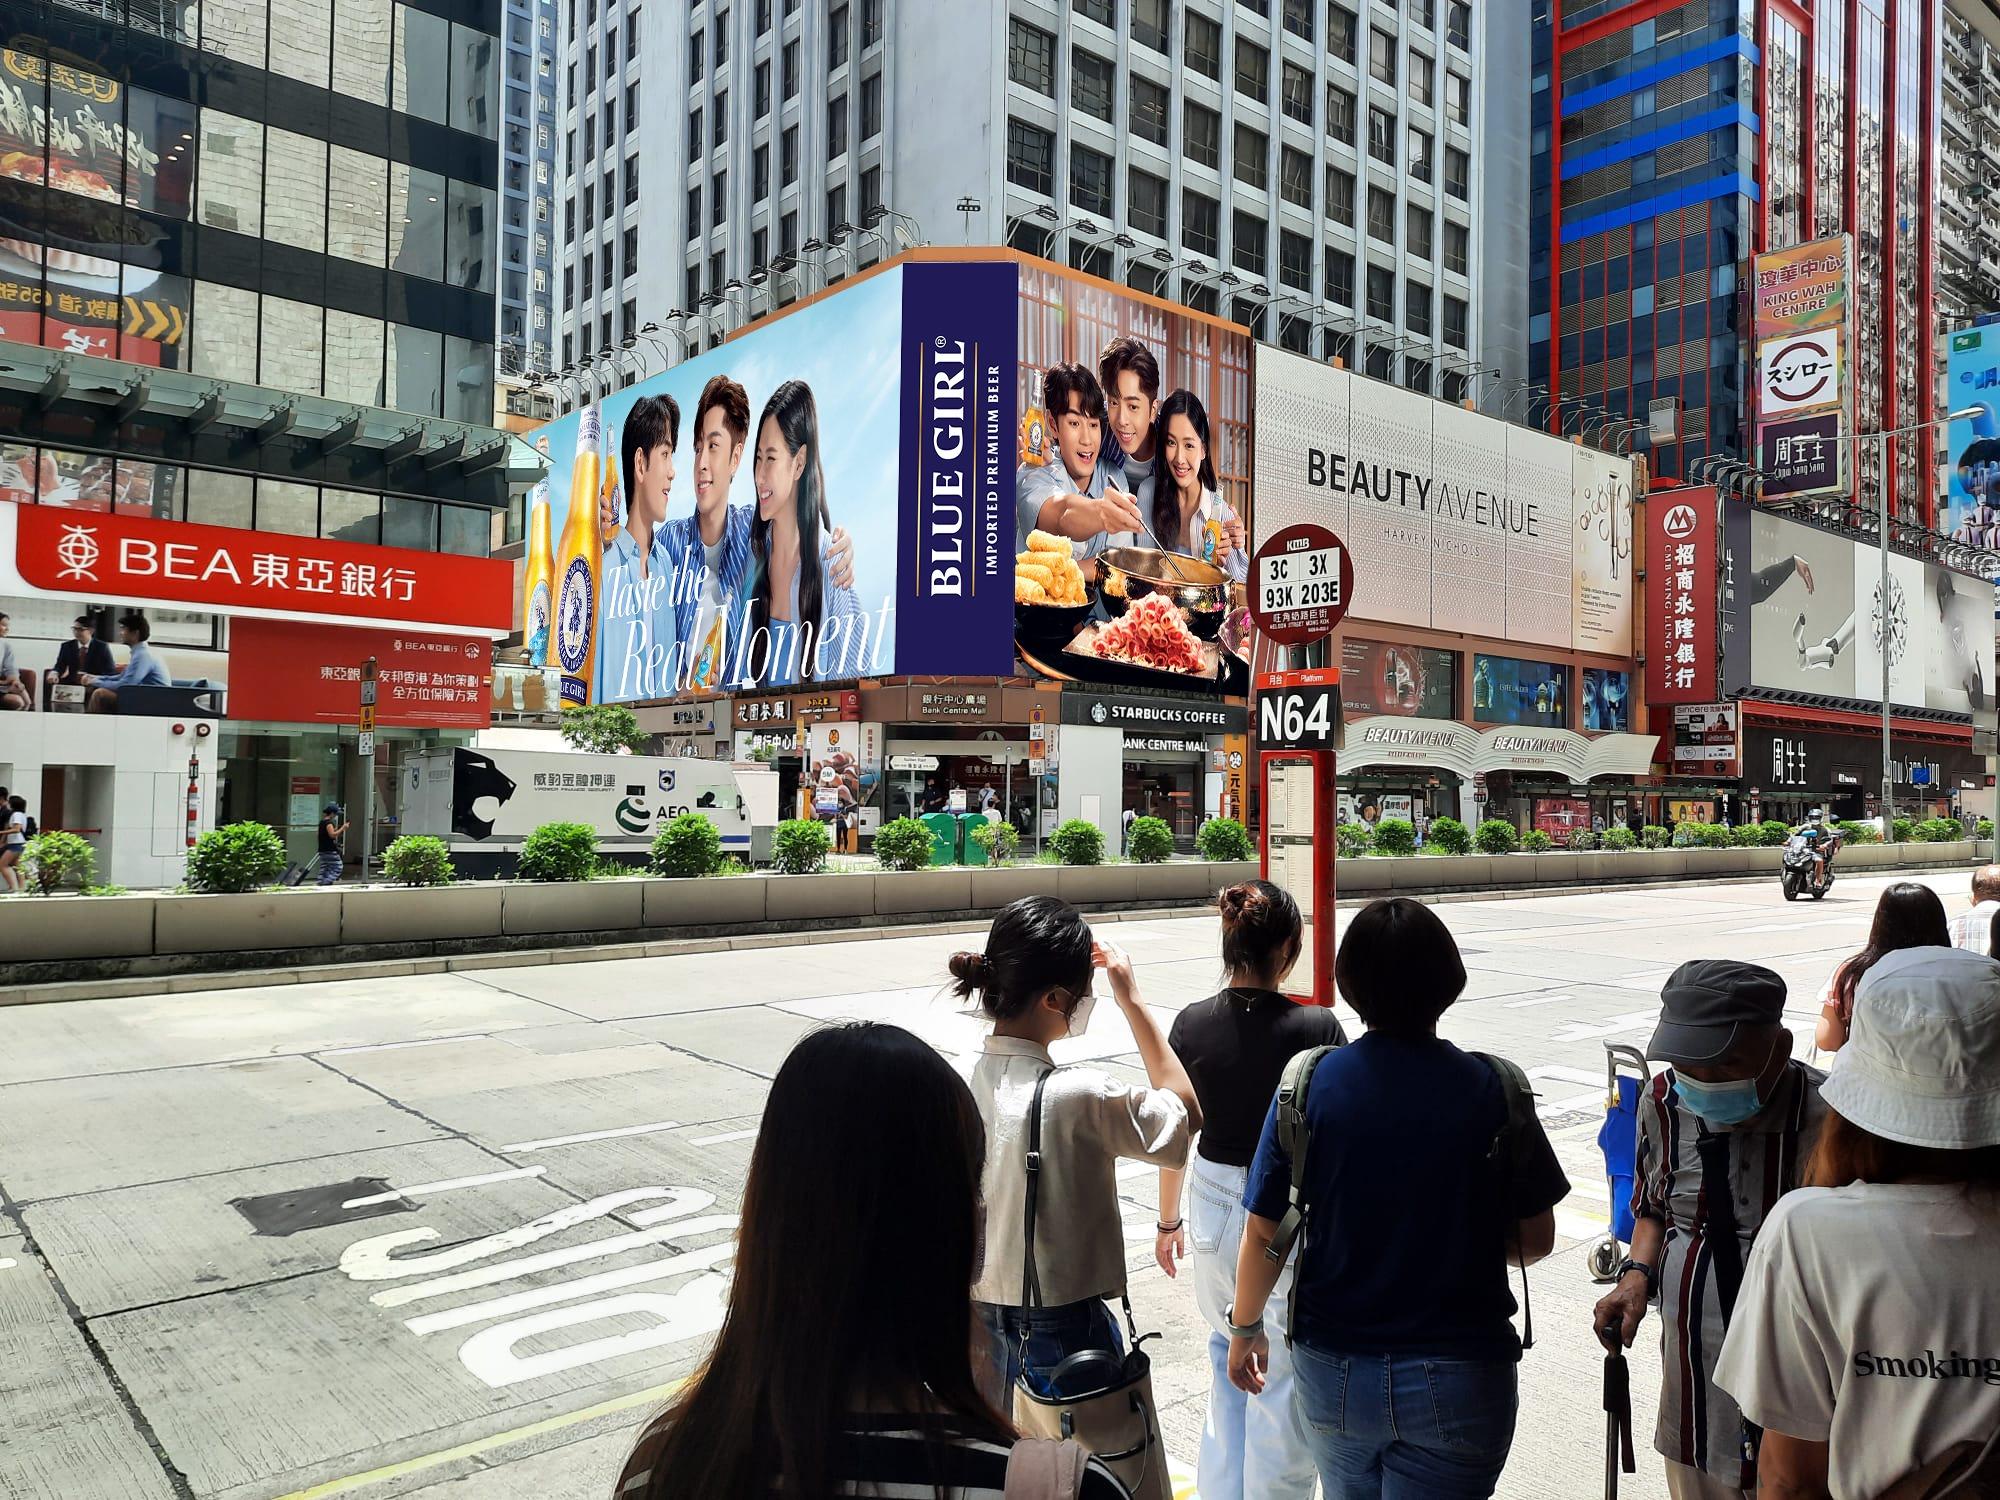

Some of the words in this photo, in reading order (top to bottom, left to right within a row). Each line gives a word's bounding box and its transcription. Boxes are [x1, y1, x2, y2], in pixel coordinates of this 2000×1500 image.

[1758, 256, 1841, 288] 瓊華中心
[1762, 289, 1799, 309] KING
[1801, 280, 1836, 300] WAH
[1772, 297, 1826, 319] CENTRE
[988, 364, 1000, 404] BEER
[1766, 361, 1833, 386] スシロー
[987, 408, 999, 486] PREMIUM
[1809, 461, 1825, 473] Sang
[931, 470, 963, 598] BLUE
[986, 490, 998, 576] IMPORTED
[1287, 538, 1310, 551] KMB
[119, 537, 242, 585] BEA
[250, 552, 417, 601] 東亞銀行
[1270, 559, 1288, 580] 3C
[1309, 553, 1327, 575] 3X
[1664, 544, 1673, 572] CMB
[605, 565, 665, 620] Taste
[669, 545, 709, 604] the
[1301, 581, 1338, 605] 203E
[1664, 576, 1673, 609] WING
[1266, 586, 1293, 609] 93K
[1674, 543, 1697, 690] 招商永隆銀行
[405, 641, 426, 650] BEA
[615, 604, 706, 698] Real
[694, 594, 895, 689] Moment
[1664, 615, 1673, 649] LUNG
[1269, 675, 1283, 685] 月台
[1301, 674, 1324, 683] Platform
[1664, 655, 1673, 689] BANK
[392, 687, 478, 703] 全方位保險方案
[922, 694, 987, 705] 銀行中心廣場
[922, 706, 941, 714] Bank
[943, 706, 969, 714] Centre
[1112, 706, 1181, 722] STARBUCKS
[1184, 710, 1226, 725] COFFEE
[1261, 694, 1331, 741] N64
[1147, 740, 1184, 751] CENTRE
[1185, 741, 1210, 752] MALL
[1773, 738, 1806, 784] 周生生
[534, 773, 616, 787] 威豹金融押運
[1230, 774, 1241, 822] 元気寿
[1854, 1350, 2000, 1386] Smoking
